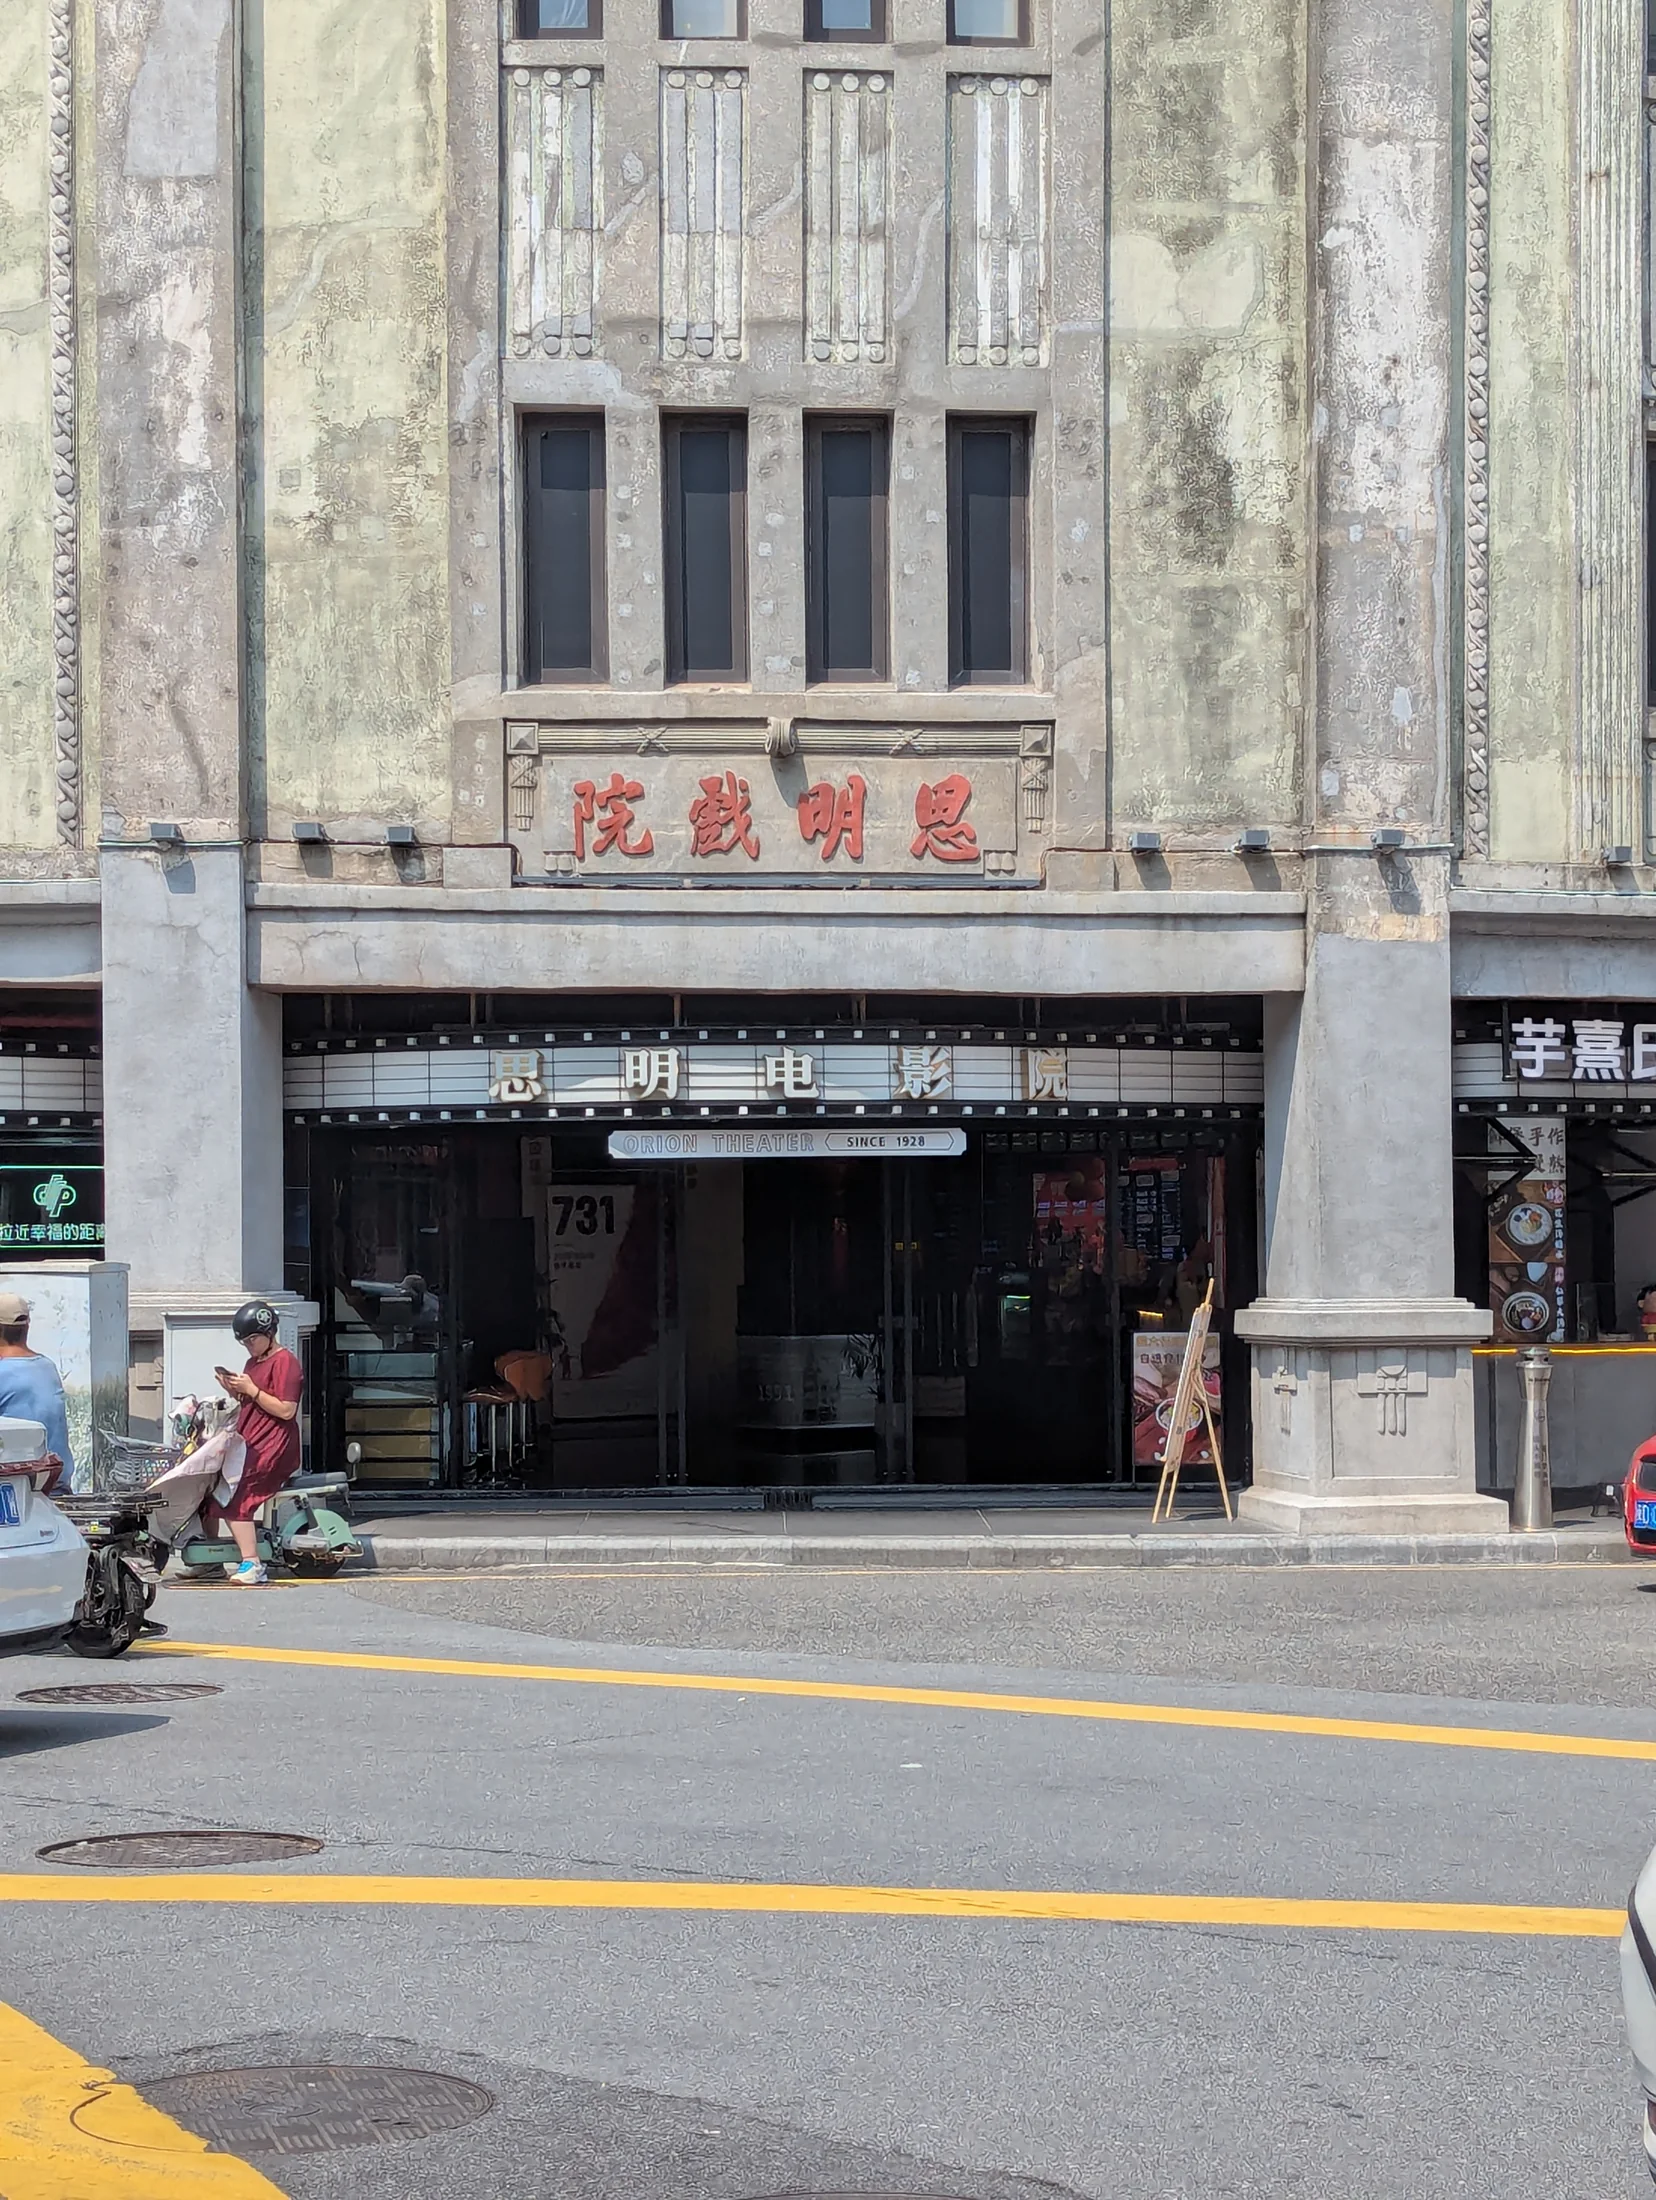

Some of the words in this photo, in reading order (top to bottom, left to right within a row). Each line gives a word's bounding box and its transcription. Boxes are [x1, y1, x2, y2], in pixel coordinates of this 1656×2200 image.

[490, 1044, 1068, 1102] 思明电影院
[622, 1133, 698, 1153] ORION
[711, 1132, 815, 1153] THEATER
[847, 1135, 886, 1148] SINCE
[896, 1134, 926, 1147] 1928
[551, 1195, 616, 1236] 731
